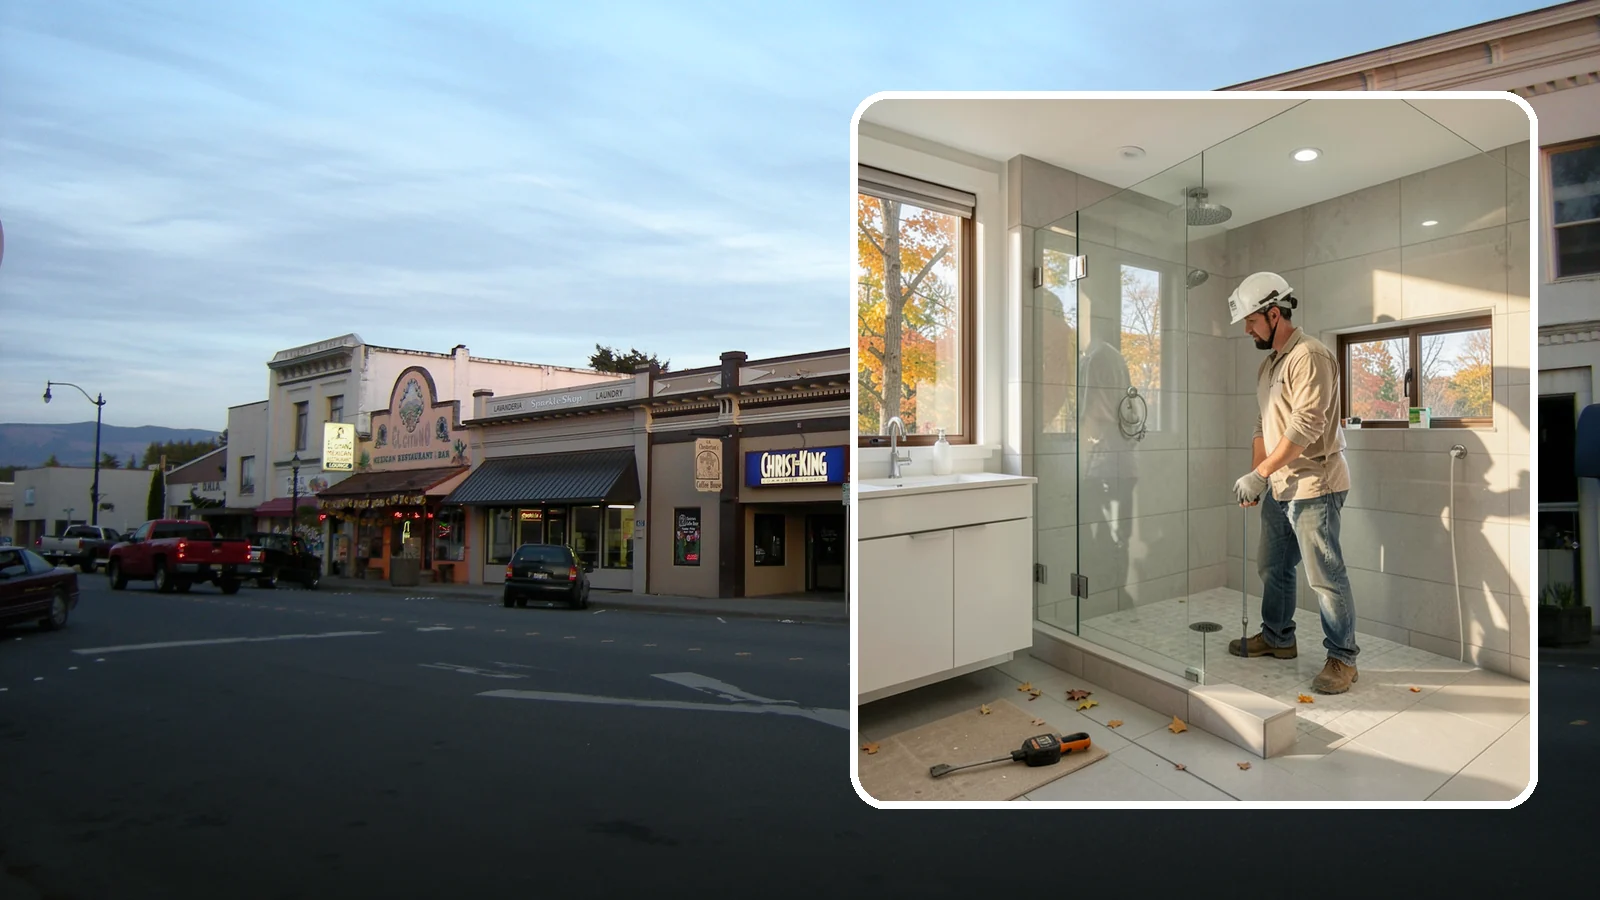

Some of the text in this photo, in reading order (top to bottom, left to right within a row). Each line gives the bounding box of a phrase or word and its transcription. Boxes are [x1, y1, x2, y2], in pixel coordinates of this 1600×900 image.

[595, 388, 623, 400] LAUNDRY
[493, 402, 522, 413] LAVANDERIA
[530, 394, 583, 410] Sparkle Shop
[373, 454, 396, 464] MEXICAN
[397, 451, 433, 462] RESTAURANT
[437, 449, 449, 459] BAR
[760, 450, 827, 478] CHRIST KING
